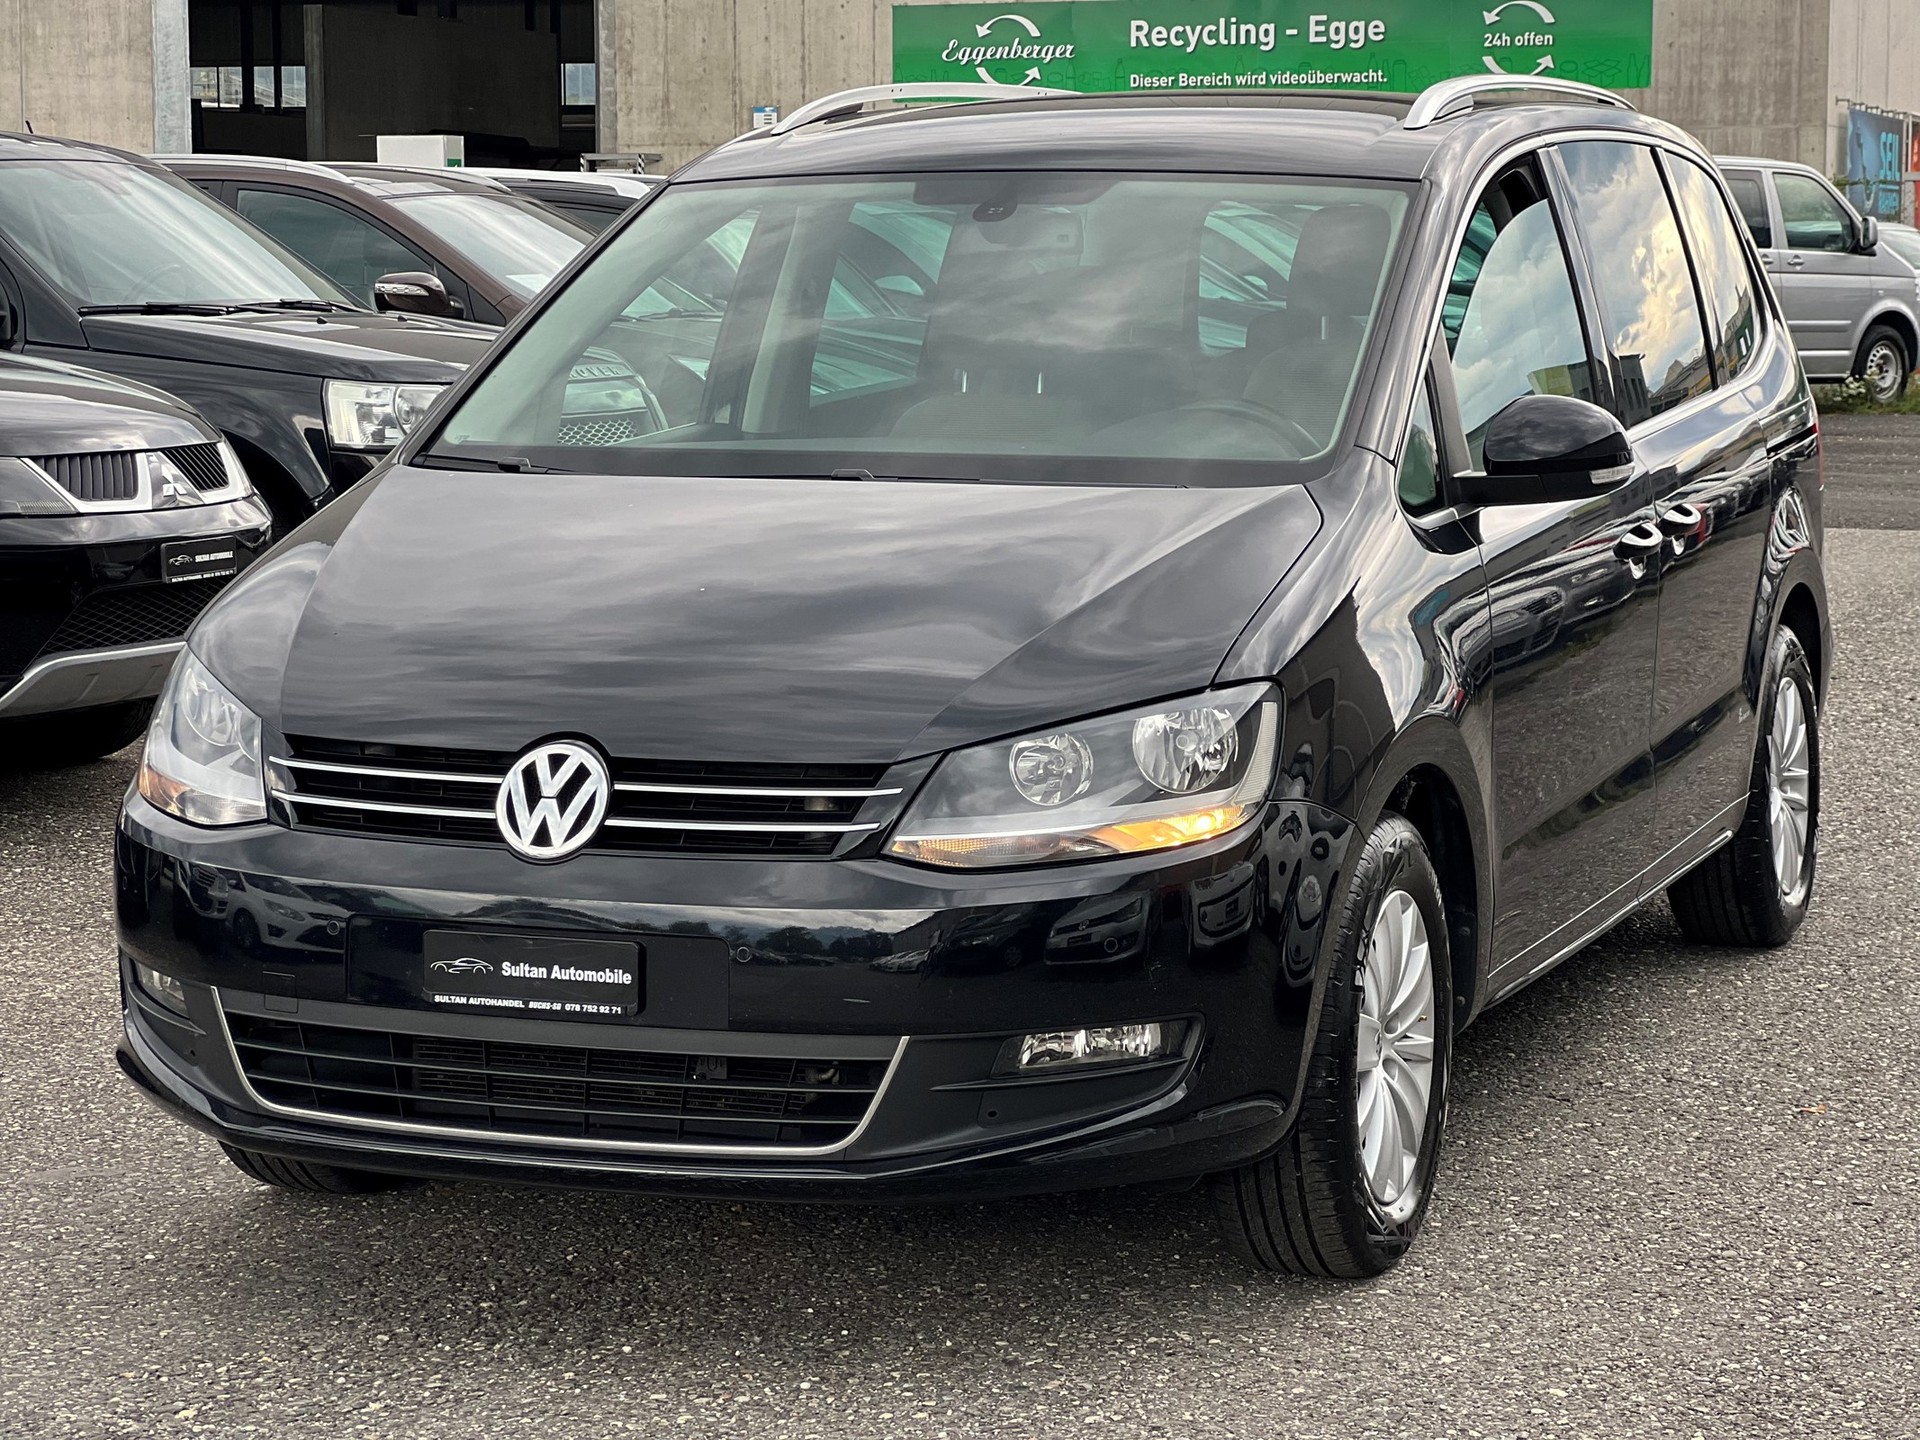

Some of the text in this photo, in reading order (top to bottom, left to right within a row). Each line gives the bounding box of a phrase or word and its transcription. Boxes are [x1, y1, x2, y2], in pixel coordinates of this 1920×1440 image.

[1130, 14, 1386, 53] Recycling - Egge
[1483, 31, 1553, 47] 24h offen
[941, 37, 1076, 66] Eggenberger
[1130, 68, 1388, 88] Dieser Bereich wird videoüberwacht.
[501, 962, 632, 985] Sultan Automobile
[434, 994, 467, 1005] SULTAN
[468, 996, 525, 1009] AUTOHANDEL
[564, 1003, 581, 1012] 078
[581, 1004, 598, 1013] 752
[598, 1005, 610, 1014] 92
[610, 1006, 622, 1015] 71
